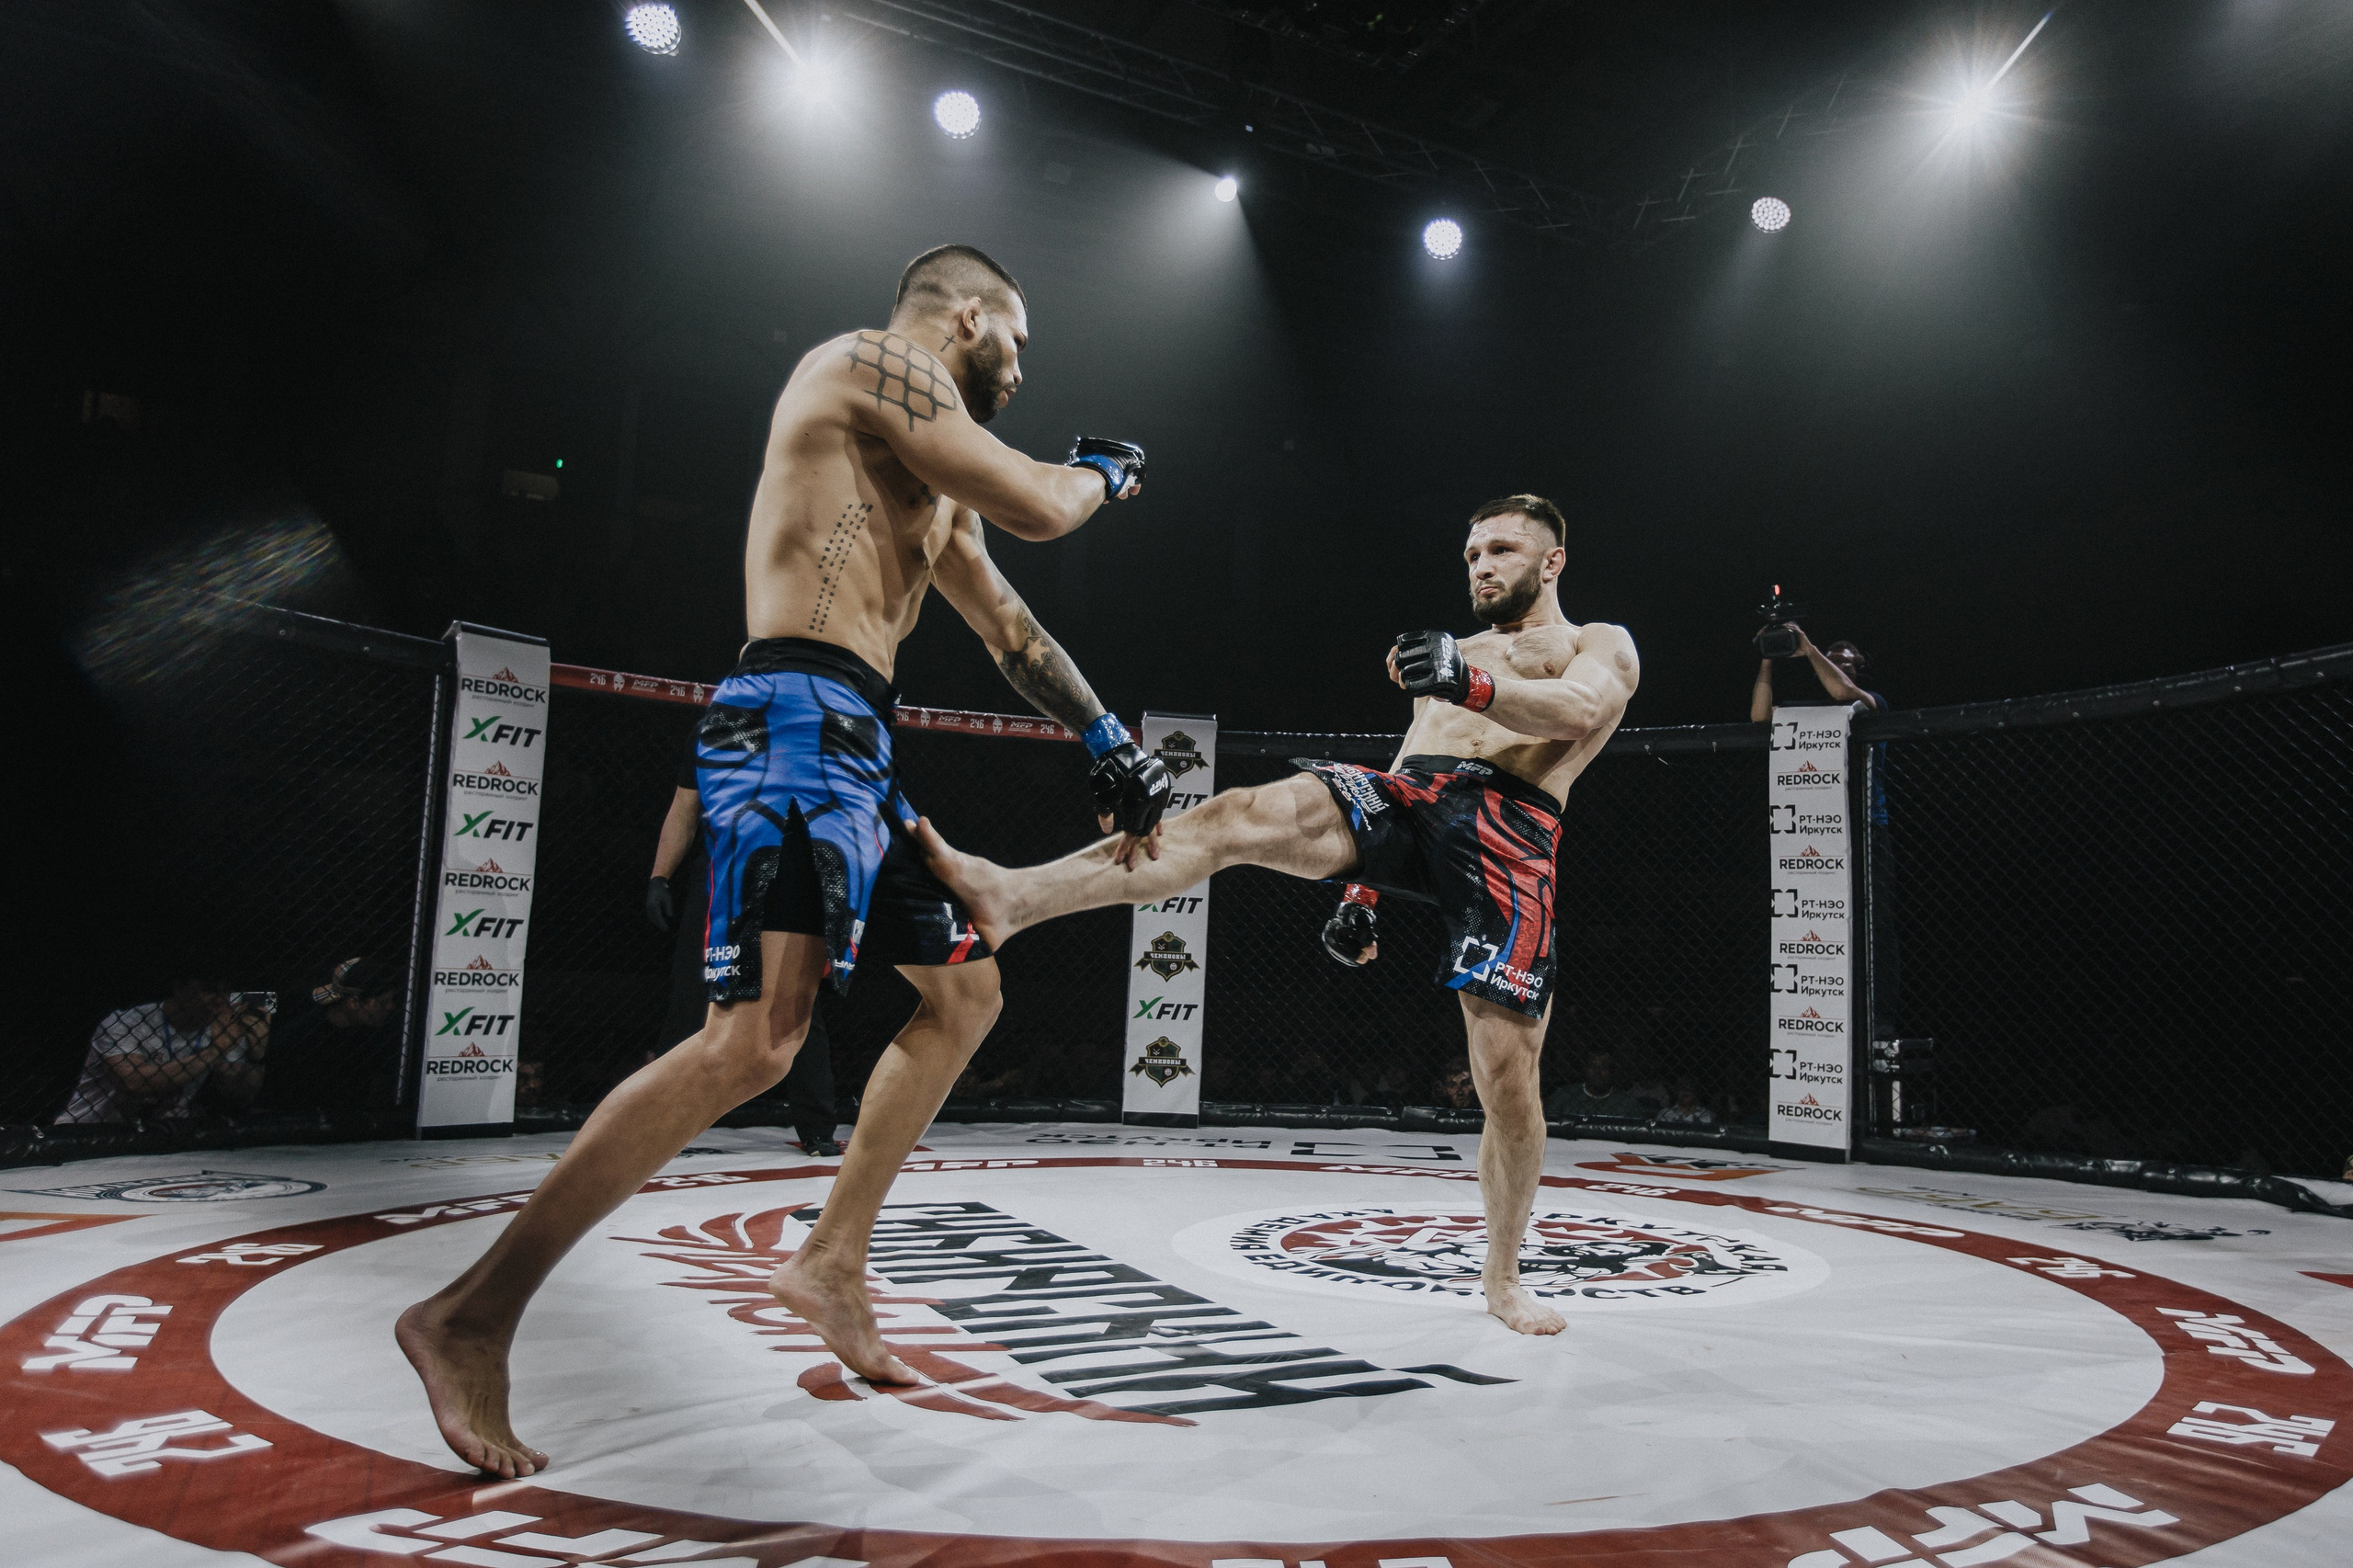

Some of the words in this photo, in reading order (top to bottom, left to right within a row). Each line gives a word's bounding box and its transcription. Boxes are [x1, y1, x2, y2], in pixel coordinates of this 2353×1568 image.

[590, 672, 606, 686] 246
[460, 677, 546, 703] REDROCK
[670, 685, 686, 697] 246
[938, 714, 961, 723] MFP
[970, 718, 984, 729] 246
[1010, 721, 1033, 729] MFP
[462, 715, 541, 747] XFIT
[1040, 724, 1054, 734] 246
[1800, 730, 1841, 740] РТ-НЭО
[1799, 741, 1841, 751] Иркутск
[1160, 750, 1196, 758] ЧЕМПИОНЫ
[1457, 761, 1494, 775] MFP
[453, 773, 539, 796] REDROCK
[1778, 773, 1841, 786] REDROCK
[1166, 793, 1209, 810] FIT
[453, 810, 534, 842] XFIT
[1800, 814, 1841, 824] РТ-НЭО
[1800, 825, 1843, 835] Иркутск
[1779, 858, 1845, 869] REDROCK
[444, 873, 530, 892] REDROCK
[1802, 900, 1845, 909] РТ-НЭО
[1802, 910, 1845, 920] Иркутск
[444, 908, 524, 938] XFIT
[1779, 943, 1845, 955] REDROCK
[434, 971, 519, 986] REDROCK
[1495, 961, 1543, 988] РТ-НЭО
[1801, 975, 1844, 986] РТ-НЭО
[1490, 973, 1540, 1000] Иркутск
[1801, 986, 1844, 997] Иркутск
[1132, 996, 1199, 1021] XFIT
[435, 1006, 516, 1036] XFIT
[1779, 1018, 1844, 1033] REDROCK
[426, 1059, 514, 1074] REDROCK
[1800, 1062, 1843, 1074] РТ-НЭО
[1800, 1073, 1843, 1085] Иркутск
[1777, 1105, 1842, 1121] REDROCK
[1142, 1158, 1218, 1167] 246
[1586, 1183, 1680, 1196] 246
[1529, 1212, 1789, 1271] РКУТСКАЯ
[176, 1243, 324, 1266] 246
[2006, 1256, 2137, 1279] 246
[22, 1294, 174, 1370] MFP
[2154, 1306, 2316, 1374] MFP
[2167, 1401, 2336, 1458] 246
[41, 1409, 274, 1477] 246
